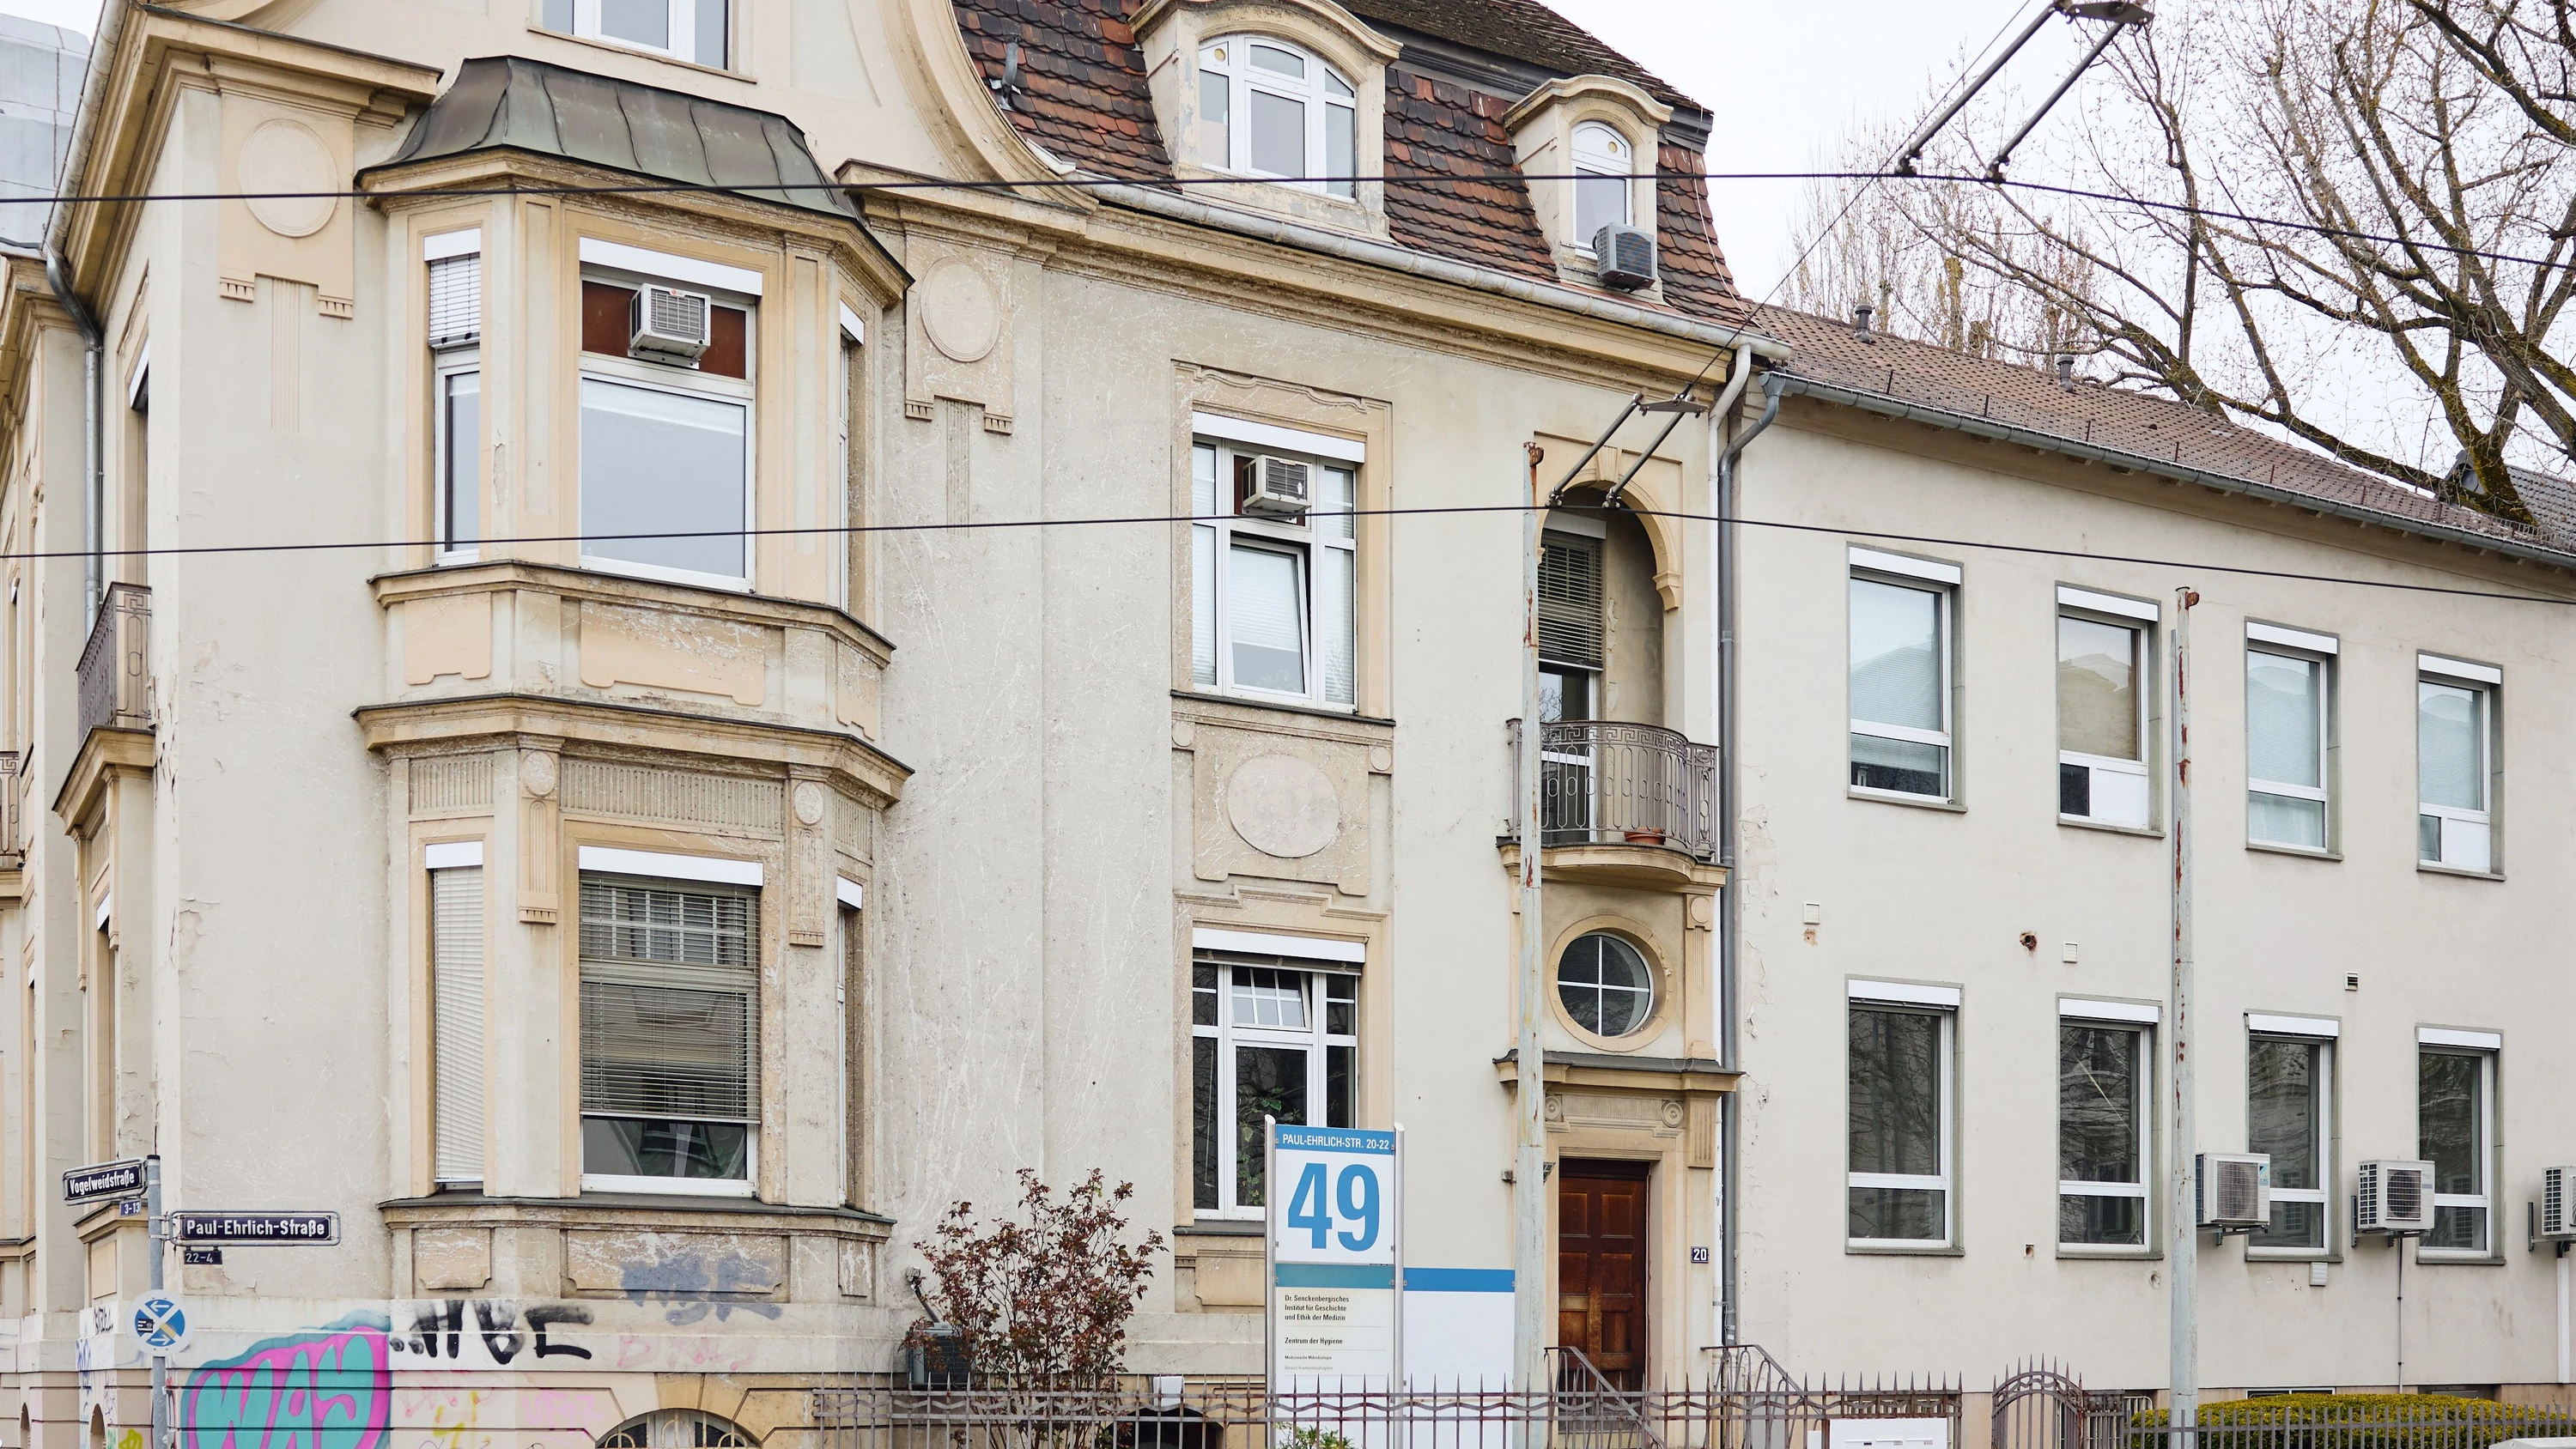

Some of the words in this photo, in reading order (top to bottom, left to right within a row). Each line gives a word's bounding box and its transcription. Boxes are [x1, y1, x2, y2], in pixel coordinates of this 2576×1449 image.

[1282, 1134, 1364, 1149] PAUL-EHRLICH-STR.
[1366, 1138, 1389, 1150] 20-22
[70, 1169, 135, 1196] Vogelweidstraße
[124, 1202, 141, 1215] 3-13
[1287, 1162, 1381, 1252] 49
[186, 1219, 325, 1238] Paul-Ehrlich-Straße
[185, 1252, 214, 1264] 22-4
[1692, 1248, 1707, 1261] 20
[1294, 1294, 1350, 1303] Senckenbergisches
